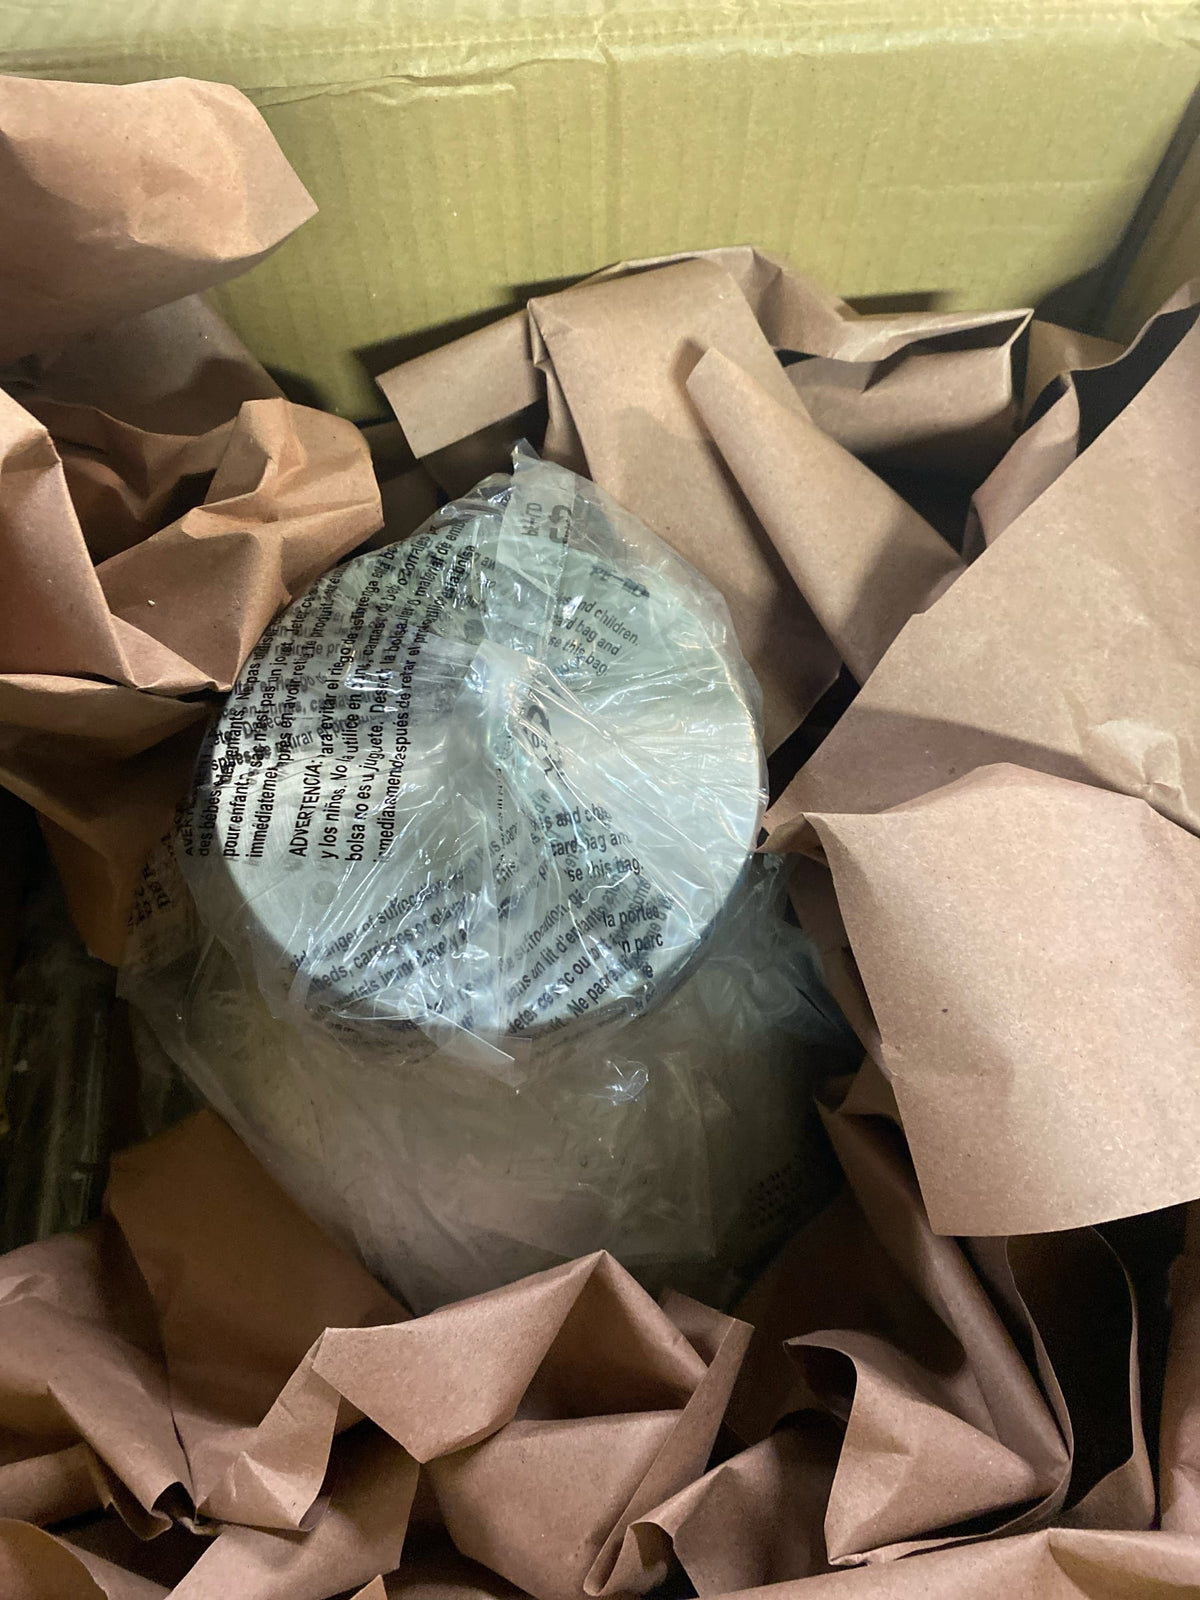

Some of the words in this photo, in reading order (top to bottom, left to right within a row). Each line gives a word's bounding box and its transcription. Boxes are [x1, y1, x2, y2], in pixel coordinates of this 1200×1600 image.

[593, 606, 640, 647] children.
[576, 620, 599, 643] bag
[598, 636, 622, 657] and
[408, 644, 422, 657] el
[327, 678, 339, 691] el
[321, 693, 337, 731] evitar
[350, 694, 362, 710] en
[341, 713, 360, 754] utilice
[360, 721, 386, 773] juguete.
[223, 823, 241, 857] pour
[261, 685, 277, 708] pas
[330, 763, 349, 782] No
[359, 784, 372, 800] es
[289, 760, 324, 858] ADVERTENCIA:
[323, 784, 348, 823] niños.
[355, 802, 369, 821] no
[318, 826, 339, 848] los
[345, 824, 367, 862] bolsa
[320, 849, 340, 860] y
[545, 948, 560, 967] lit
[572, 956, 591, 976] ou
[566, 996, 590, 1018] Ne
